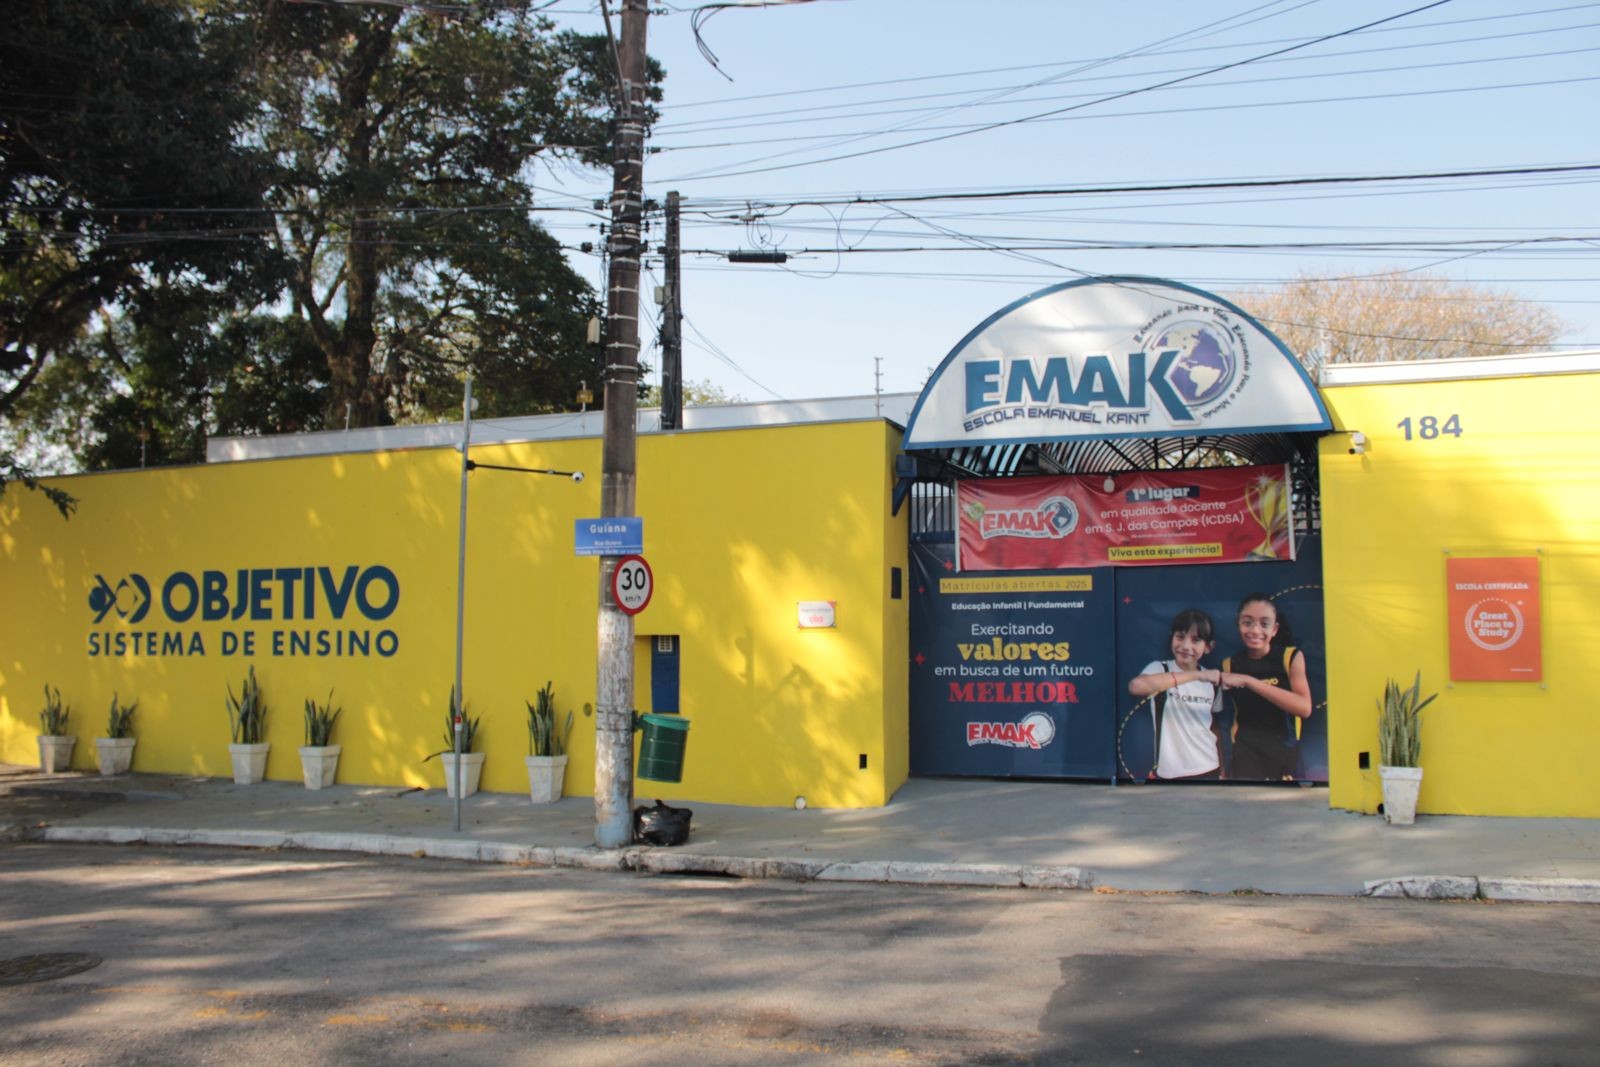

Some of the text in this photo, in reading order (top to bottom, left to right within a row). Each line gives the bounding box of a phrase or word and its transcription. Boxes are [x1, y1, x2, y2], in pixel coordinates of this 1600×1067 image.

[965, 350, 1195, 421] EMAK
[963, 407, 1150, 432] ESCOLA EMANUEL KANT
[1397, 414, 1463, 441] 184
[1150, 487, 1190, 502] lugar
[1085, 512, 1245, 534] em S. J. dos Campos (ICDSA)
[1101, 502, 1226, 521] em qualidade docente
[590, 523, 627, 534] Guiana
[983, 511, 1060, 536] EMAK
[1111, 545, 1220, 558] Viva esta experiência!
[621, 567, 646, 590] 30
[1012, 580, 1062, 590] abertas
[1065, 579, 1087, 589] 2025
[161, 565, 400, 623] OBJETIVO
[952, 602, 991, 612] Educação
[992, 601, 1022, 610] Infantil
[1028, 600, 1084, 610] Fundamental
[971, 622, 1054, 636] Exercitando
[88, 629, 399, 657] SISTEMA DE ENSINO
[957, 637, 1070, 661] valores
[934, 664, 1094, 676] em busca de um futuro
[948, 681, 1079, 704] MELHOR
[968, 722, 1040, 748] EMAK
